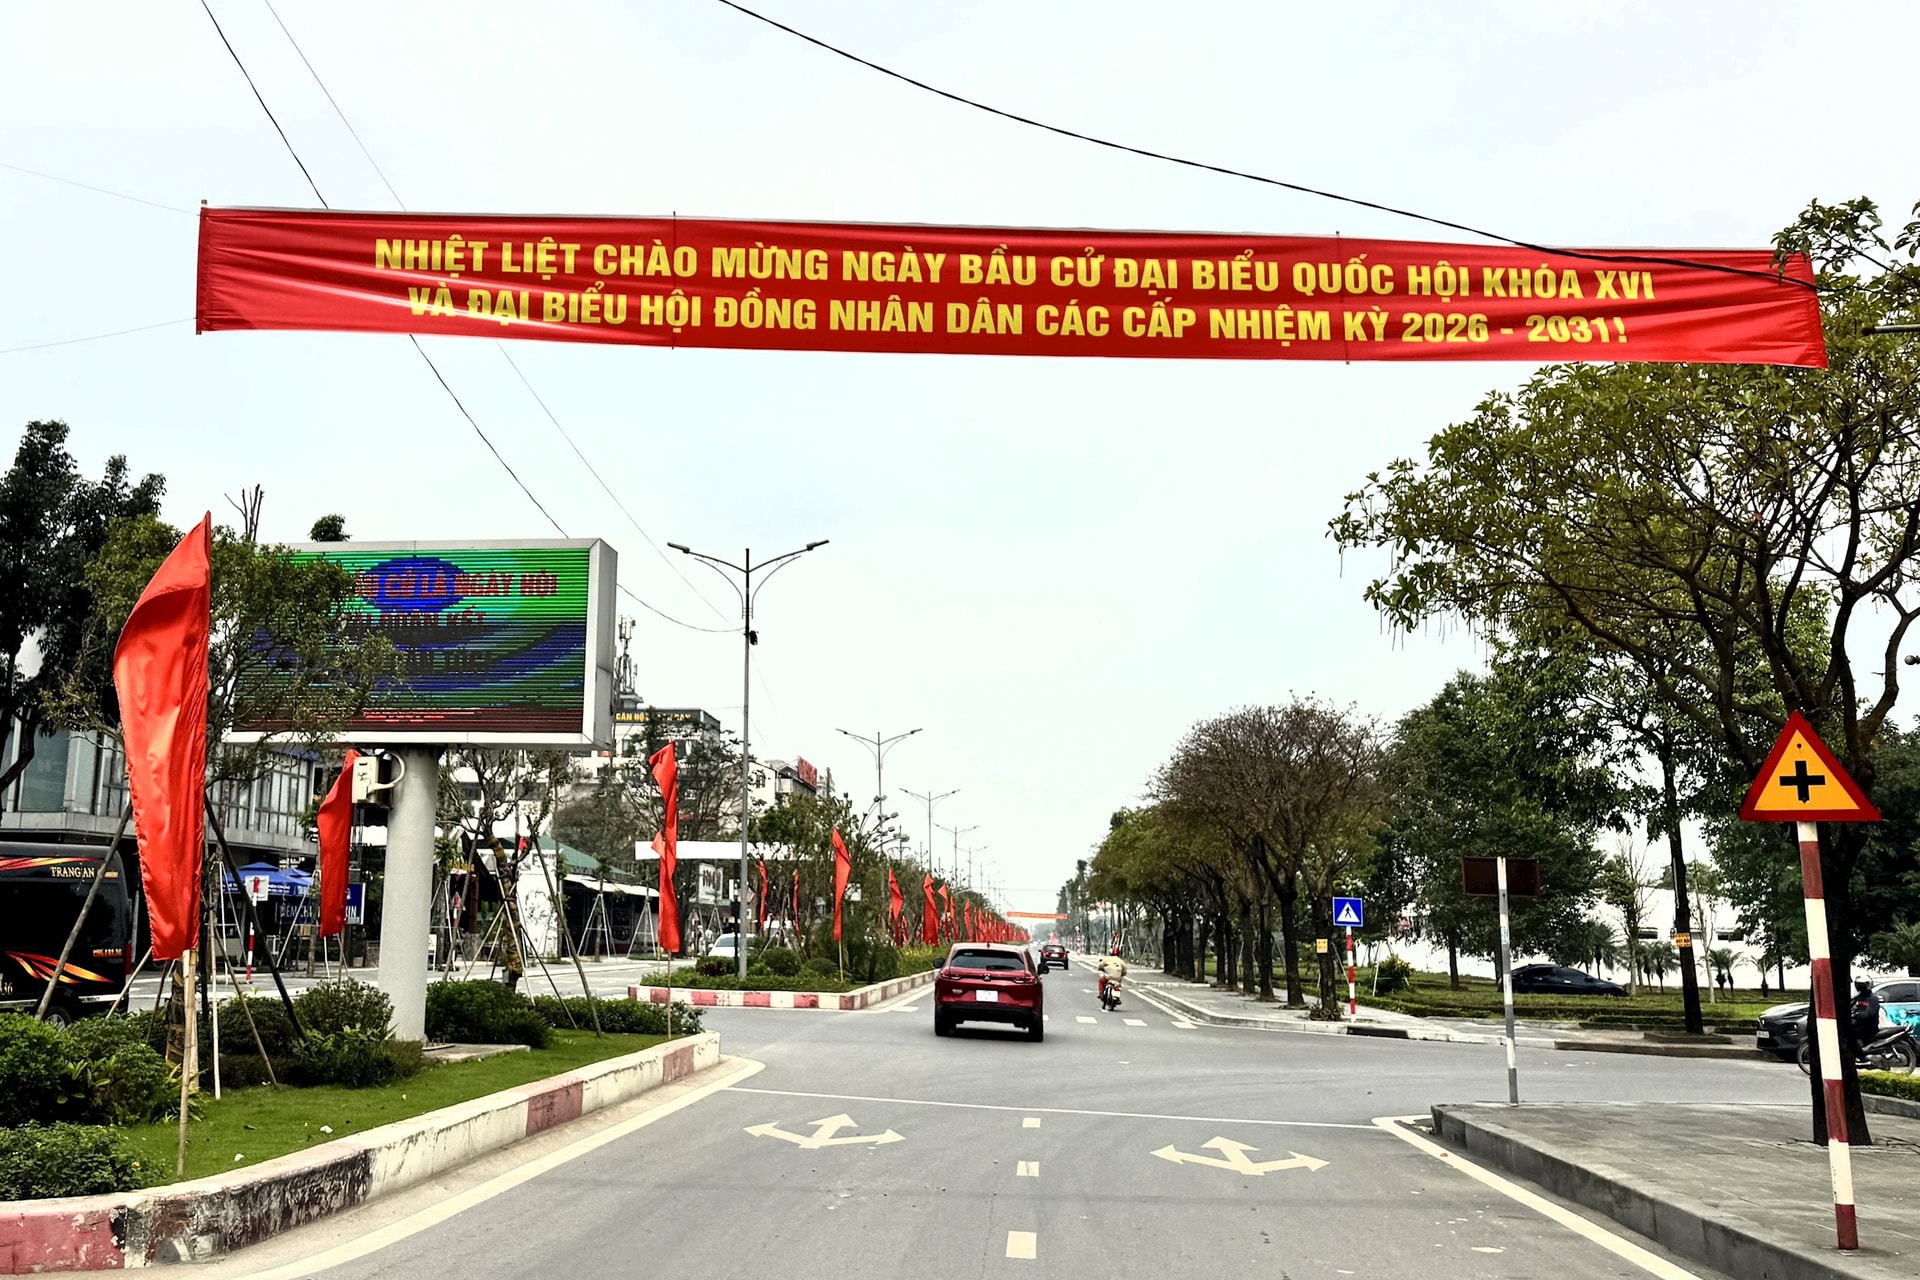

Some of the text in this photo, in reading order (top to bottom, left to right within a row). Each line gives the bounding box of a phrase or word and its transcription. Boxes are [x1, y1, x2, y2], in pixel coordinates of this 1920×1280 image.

[375, 234, 1655, 303] NHIỆT LIỆT CHÀO MỪNG NGÀY BẦU CỬ ĐẠI BIỂU QUỐC HỘI KHÓA XVI
[408, 280, 1628, 348] VÀ ĐẠI BIỂU HỘI ĐỒNG NHÂN DÂN CÁC CẤP NHIỆM KỲ 2026 - 2031!
[454, 568, 514, 597] NGÀY
